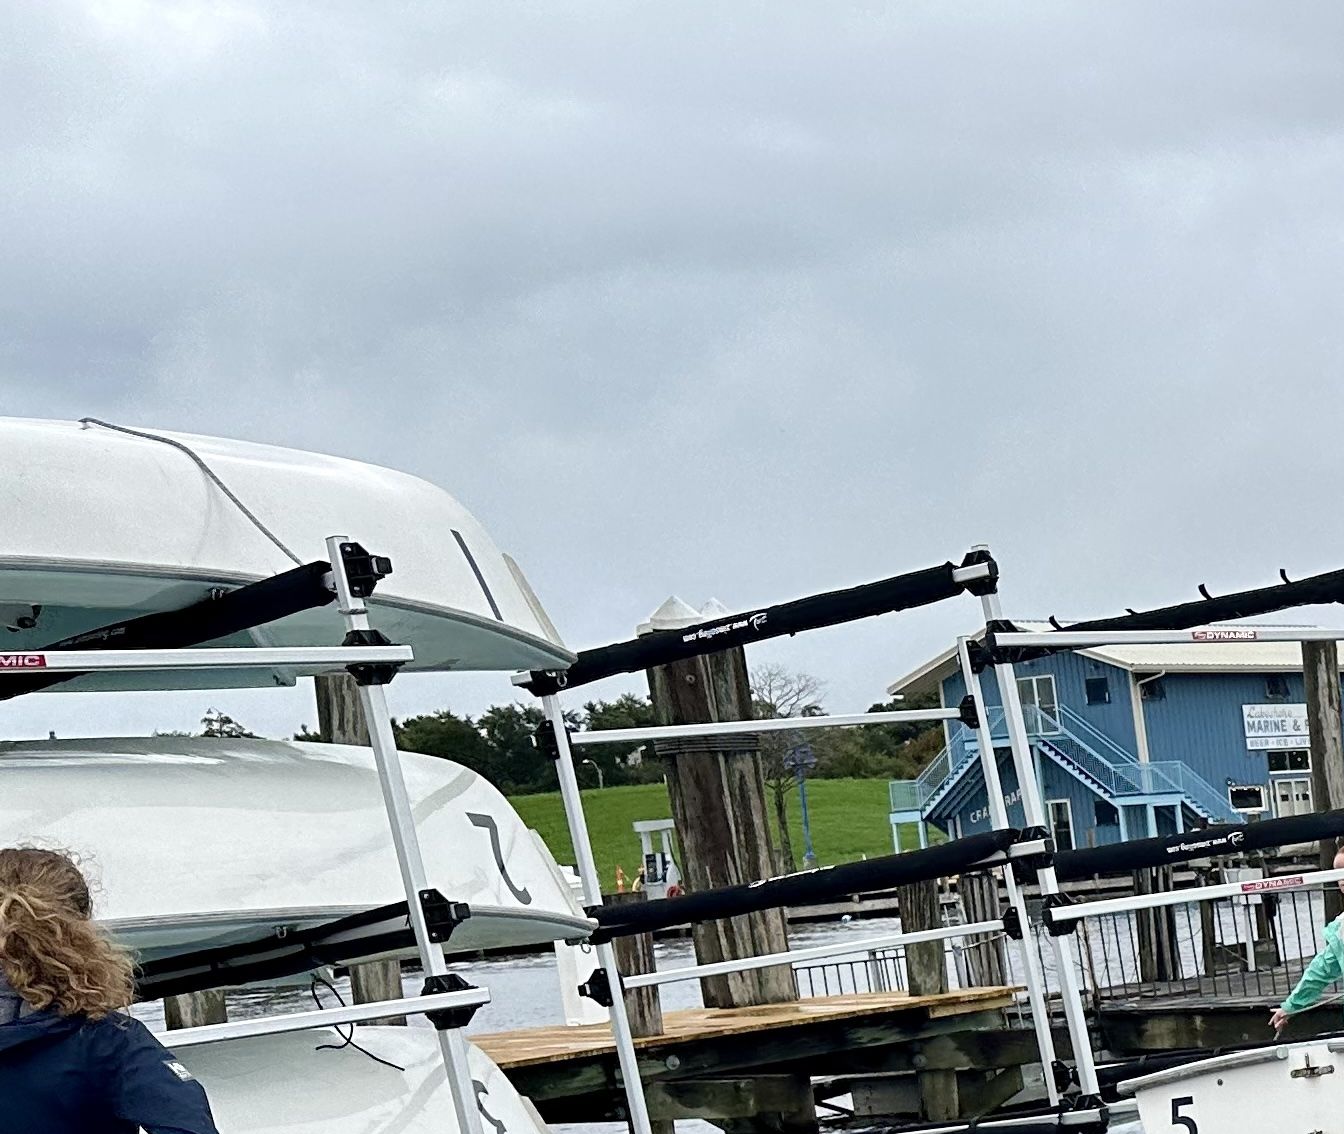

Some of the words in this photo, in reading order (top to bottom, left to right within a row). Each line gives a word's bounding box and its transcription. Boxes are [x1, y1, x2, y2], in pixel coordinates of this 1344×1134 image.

[1206, 631, 1255, 640] DYNAMIC
[1246, 719, 1288, 734] MARINE
[1292, 718, 1302, 732] &
[969, 806, 990, 824] CRA
[464, 811, 533, 906] 2
[1255, 876, 1302, 889] DYNAMIC
